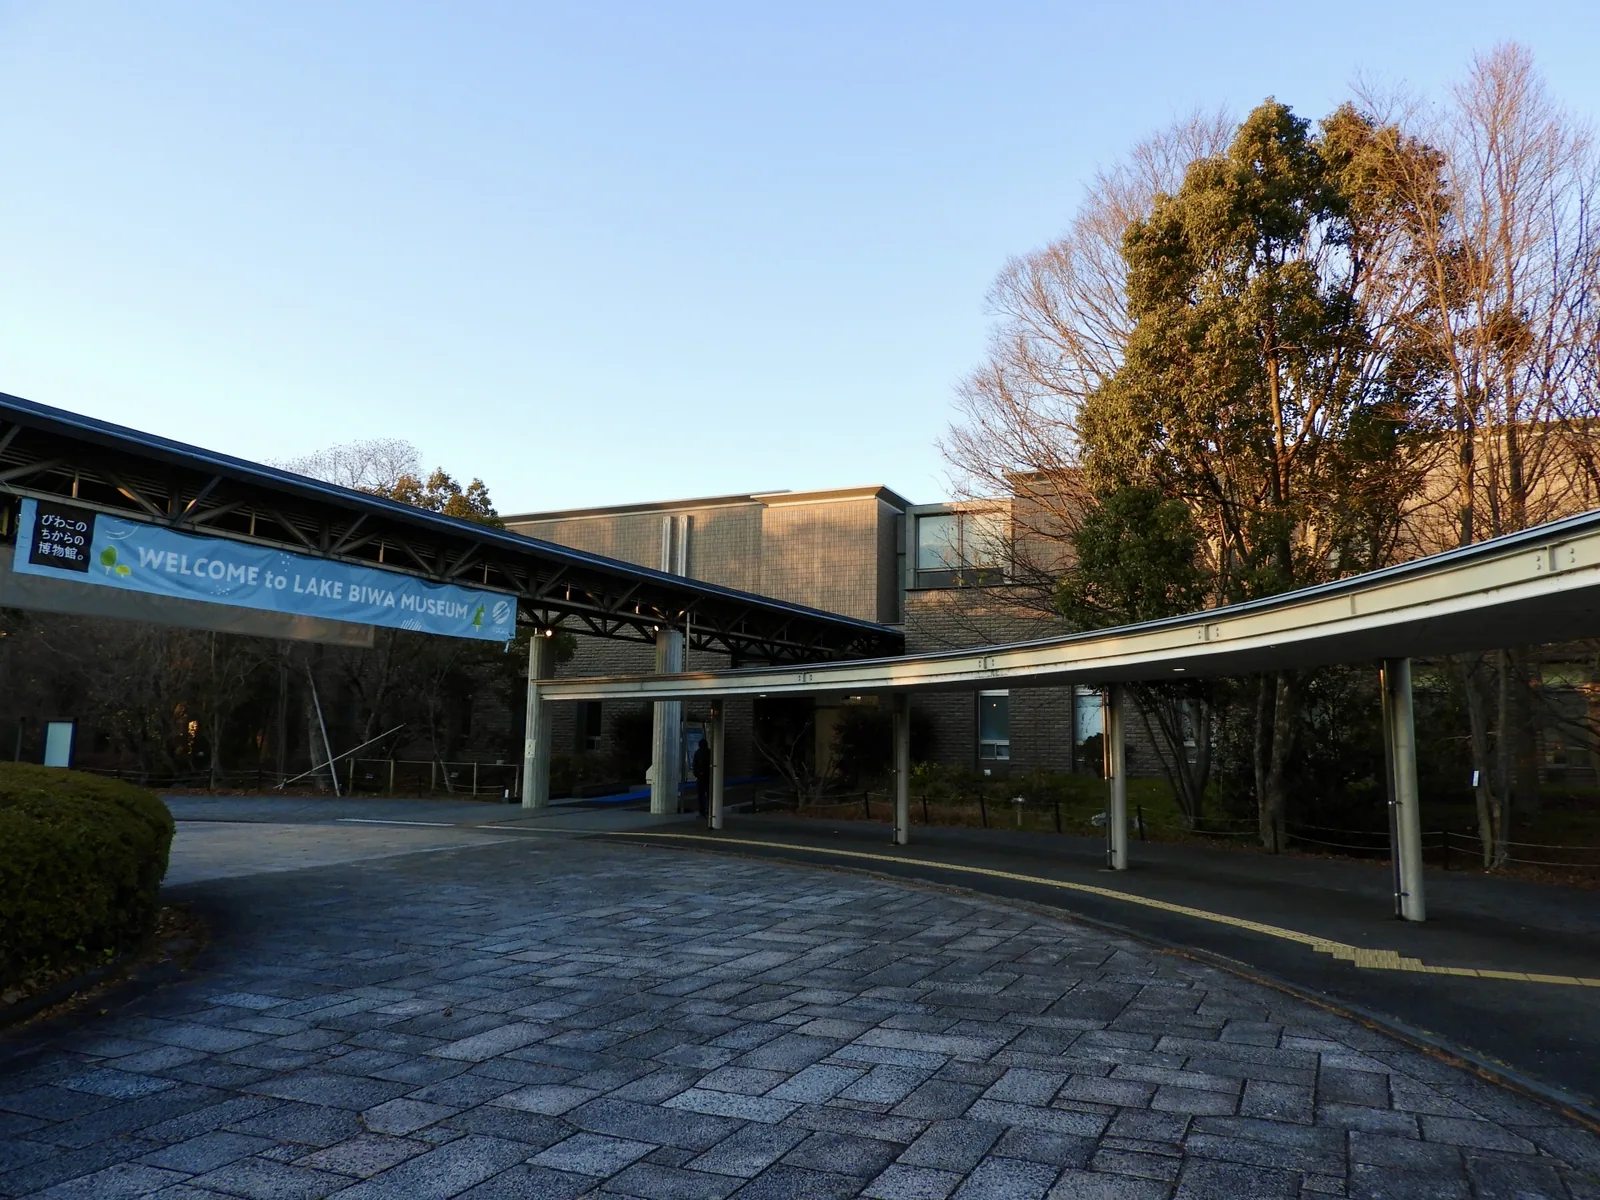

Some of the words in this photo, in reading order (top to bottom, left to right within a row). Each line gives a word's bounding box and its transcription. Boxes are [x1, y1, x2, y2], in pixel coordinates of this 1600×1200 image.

[41, 514, 88, 532] びわこの
[41, 528, 84, 546] ちからの
[139, 547, 259, 585] WELCOME
[265, 570, 287, 589] to
[293, 574, 343, 600] LAKE
[349, 584, 396, 608] BIWA
[401, 593, 468, 620] MUSEUM
